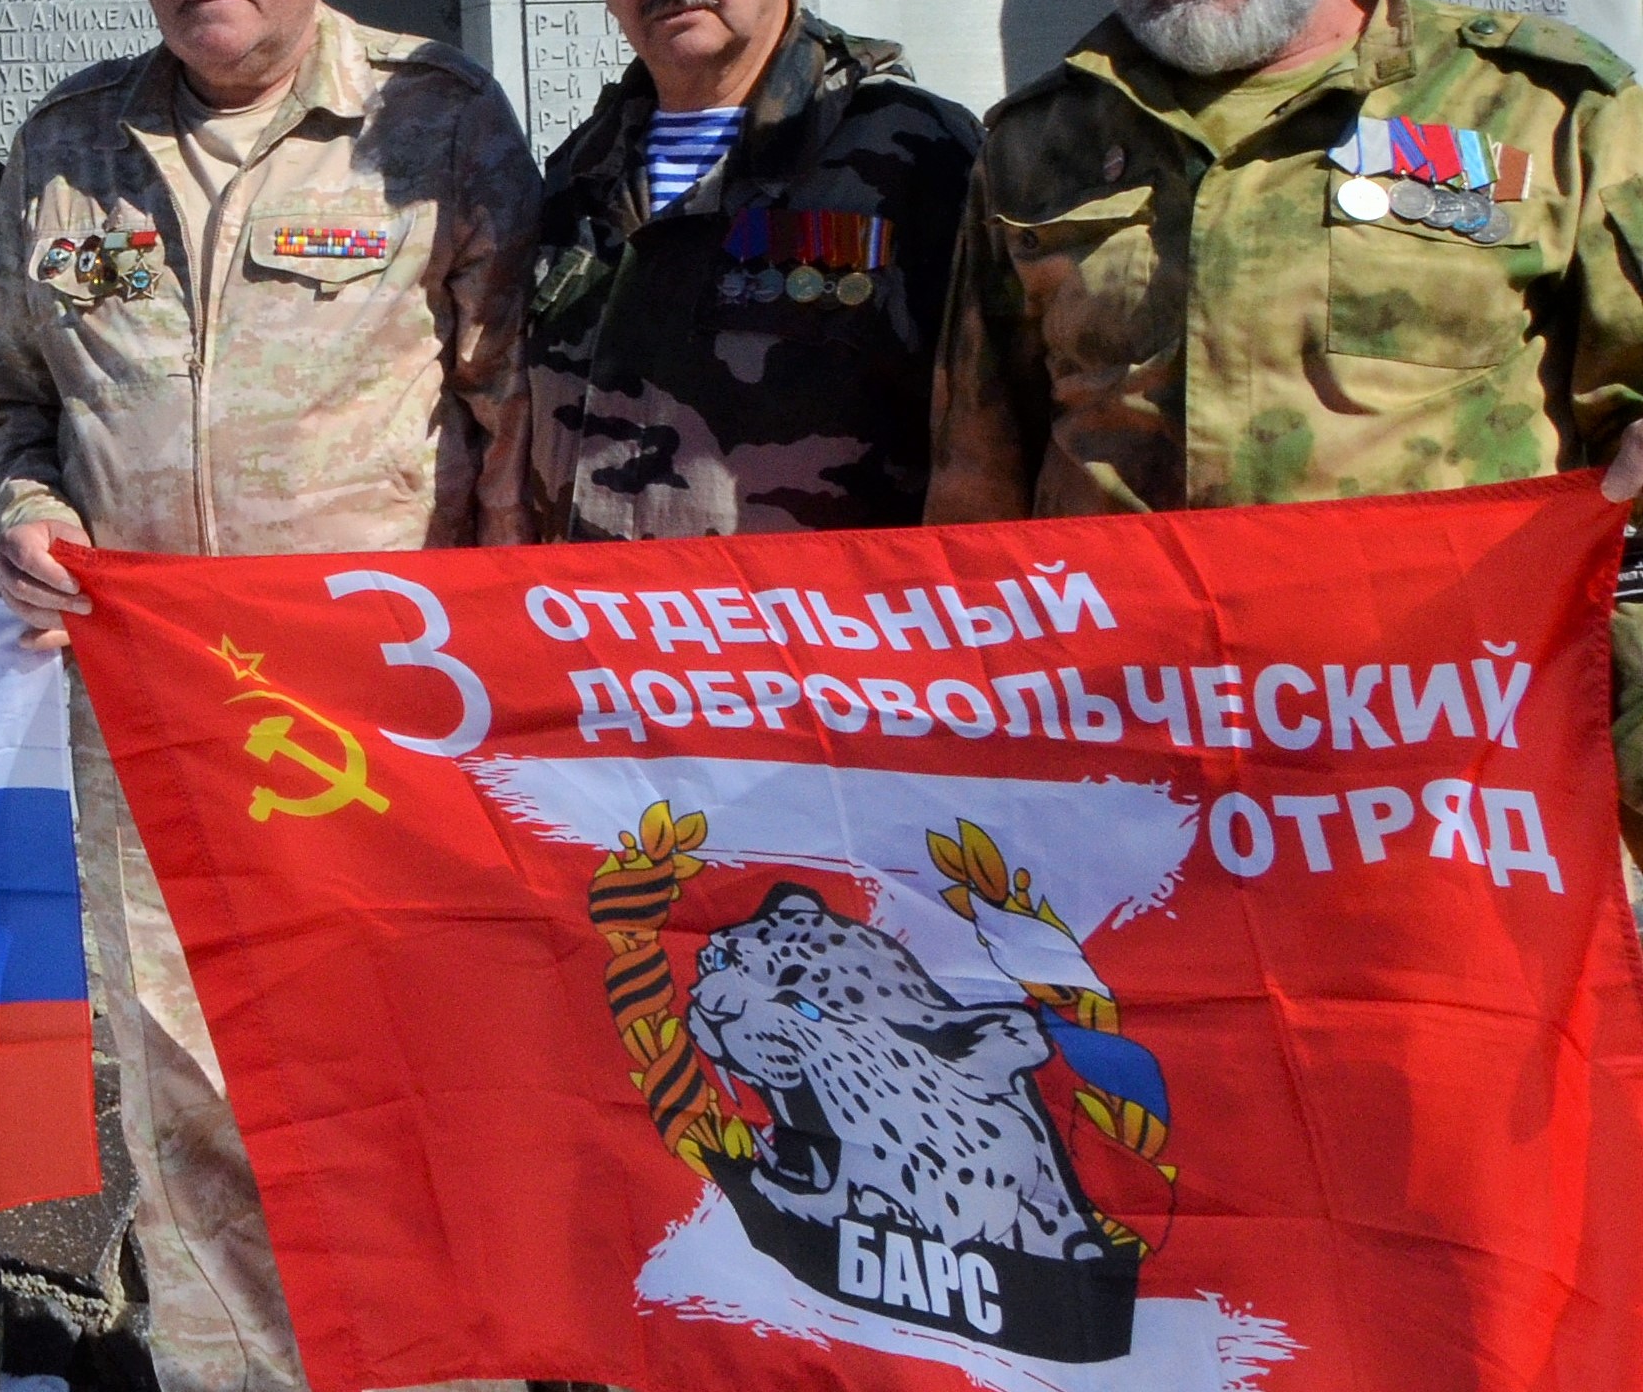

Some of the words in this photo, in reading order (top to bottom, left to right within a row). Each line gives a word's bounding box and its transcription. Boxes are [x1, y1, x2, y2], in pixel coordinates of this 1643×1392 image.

[324, 569, 493, 758] 3
[525, 559, 1118, 654] ОТДЕЛЬНЫЙ
[567, 640, 1533, 750] ДОБРОВОЛЬЧЕСКИЙ
[1209, 777, 1565, 894] ОТРЯД
[838, 1218, 1003, 1336] БАРС
